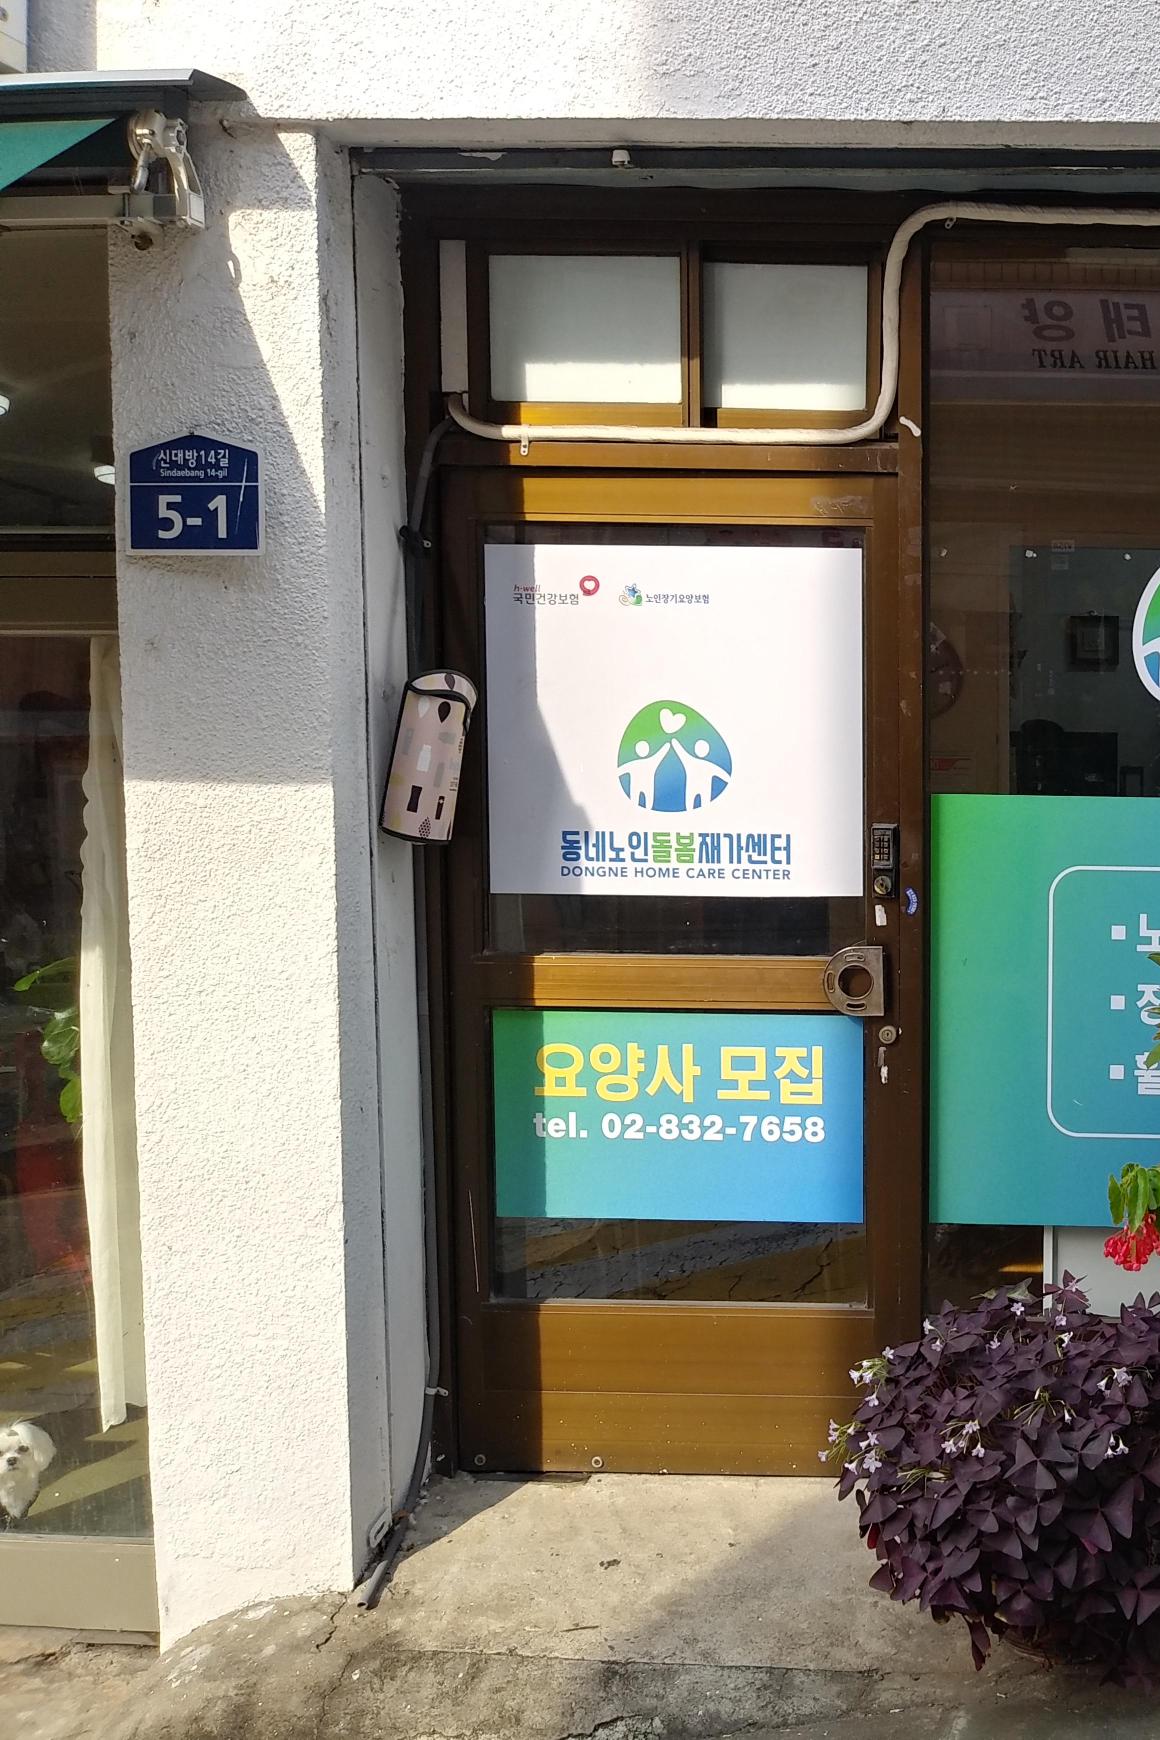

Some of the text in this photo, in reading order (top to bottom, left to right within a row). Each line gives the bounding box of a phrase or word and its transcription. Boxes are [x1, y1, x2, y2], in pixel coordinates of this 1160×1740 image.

[158, 449, 229, 467] 신대방14길
[160, 469, 228, 478] Sindaebang 14-gil
[157, 494, 227, 539] 5-1
[513, 584, 541, 593] h-well
[513, 592, 579, 606] 국민건강보험
[645, 593, 710, 605] 노인장기요양보험
[561, 830, 791, 865] 동네노인돌봄재가센터
[560, 865, 791, 881] DONGNE HOME CARE CENTER
[534, 1042, 823, 1105] 요양사 모집
[533, 1111, 826, 1142] tel. 02-832-7658
